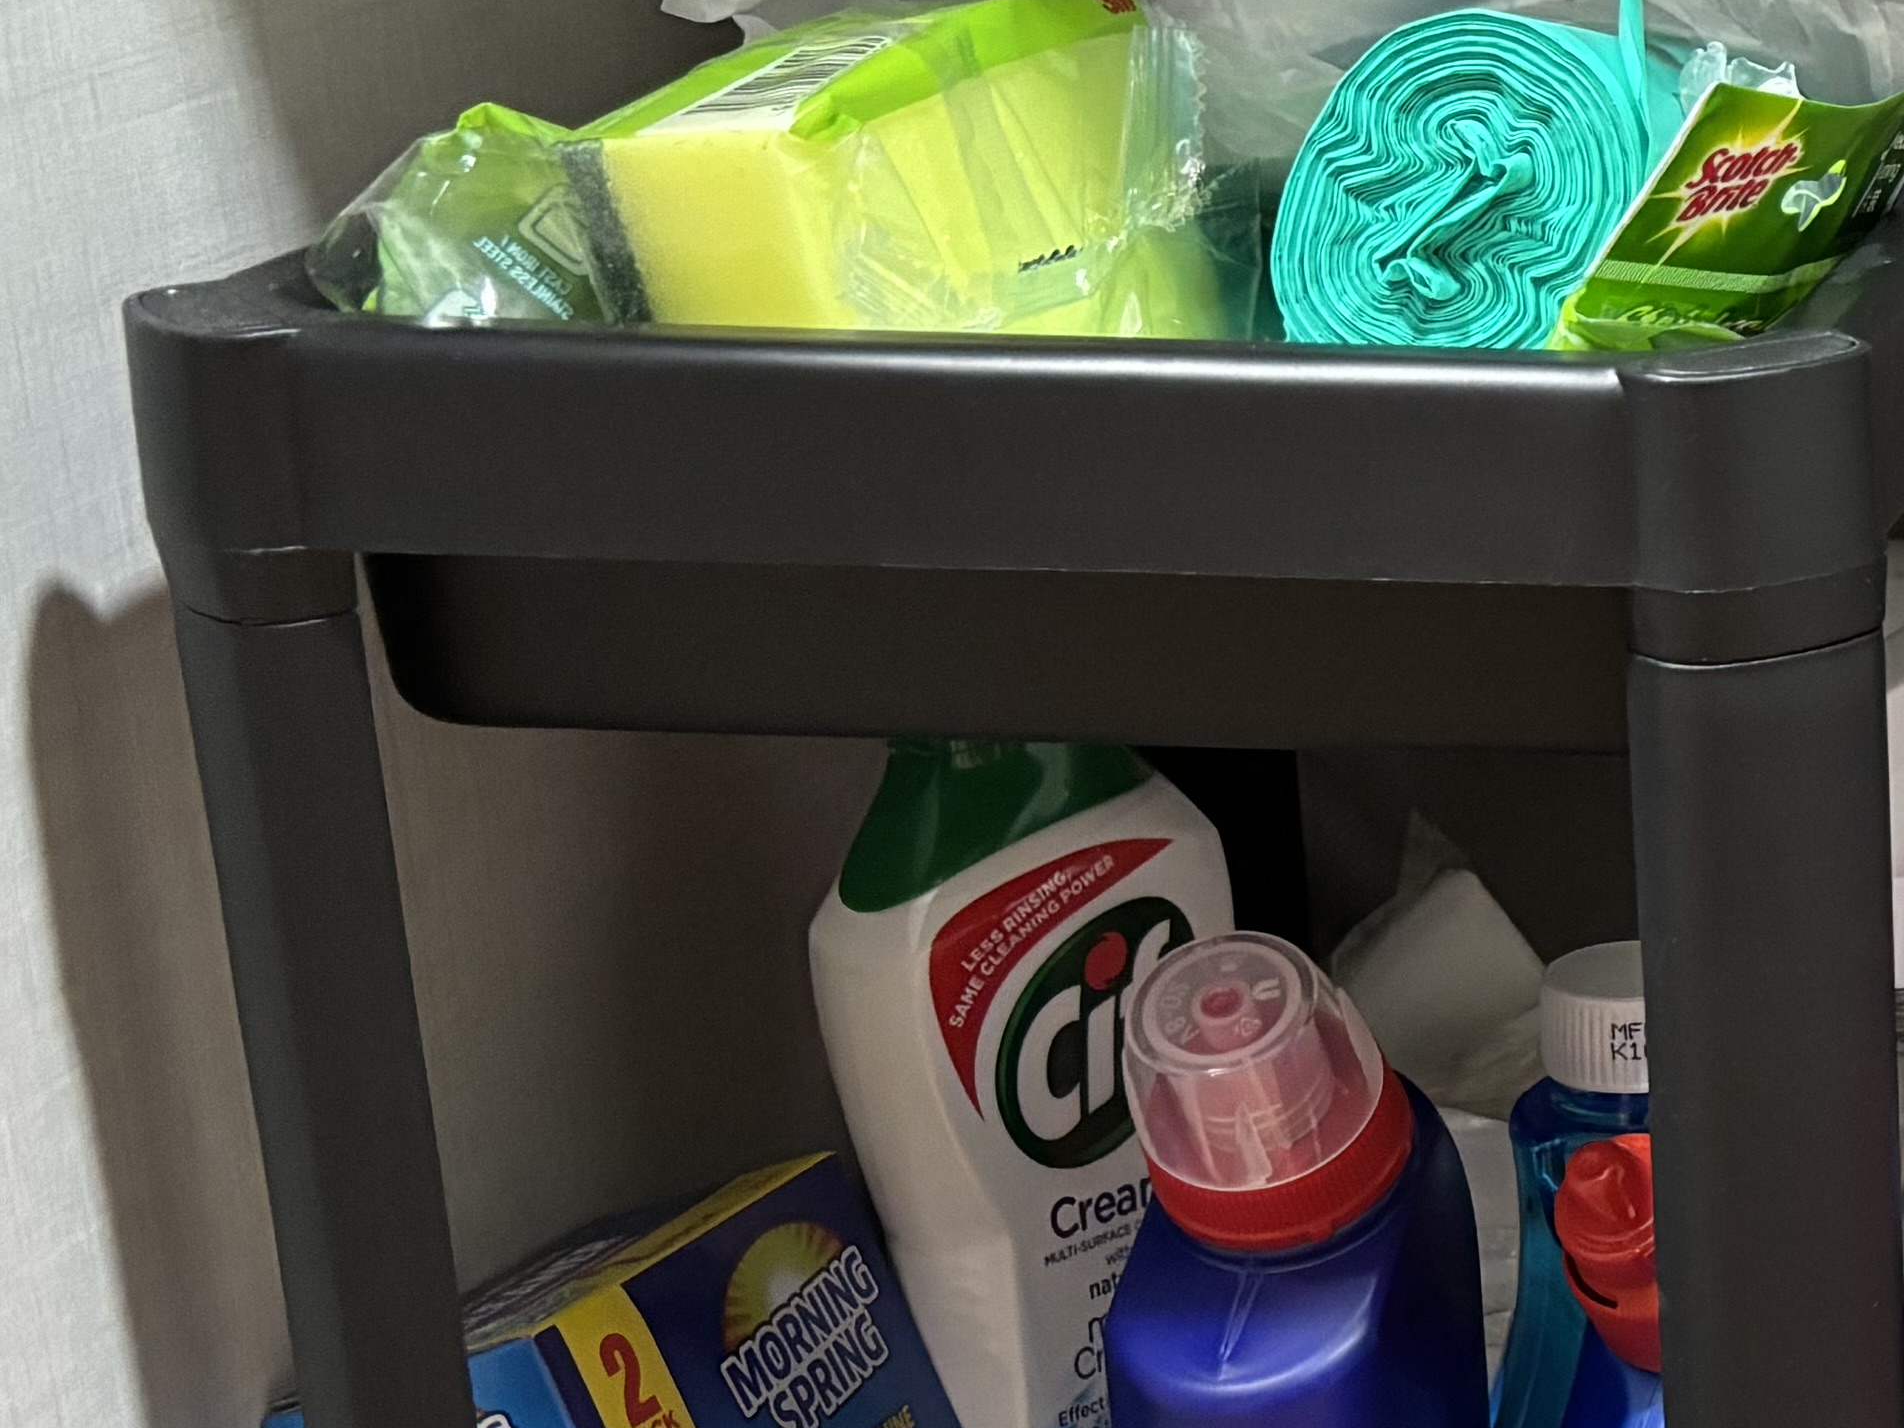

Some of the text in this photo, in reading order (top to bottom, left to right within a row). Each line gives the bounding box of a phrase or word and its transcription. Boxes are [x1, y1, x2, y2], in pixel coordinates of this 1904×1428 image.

[950, 855, 1115, 1028] SAME CLEANING POWER
[961, 867, 1073, 972] LESS RINSING,
[1017, 919, 1171, 1141] Cif
[1611, 1022, 1643, 1040] MF
[1611, 1042, 1642, 1060] K1
[1044, 1221, 1131, 1266] MULTI-SURFACE
[722, 1246, 879, 1418] MORNING
[599, 1333, 664, 1428] 2
[1058, 1398, 1105, 1428] Effect
